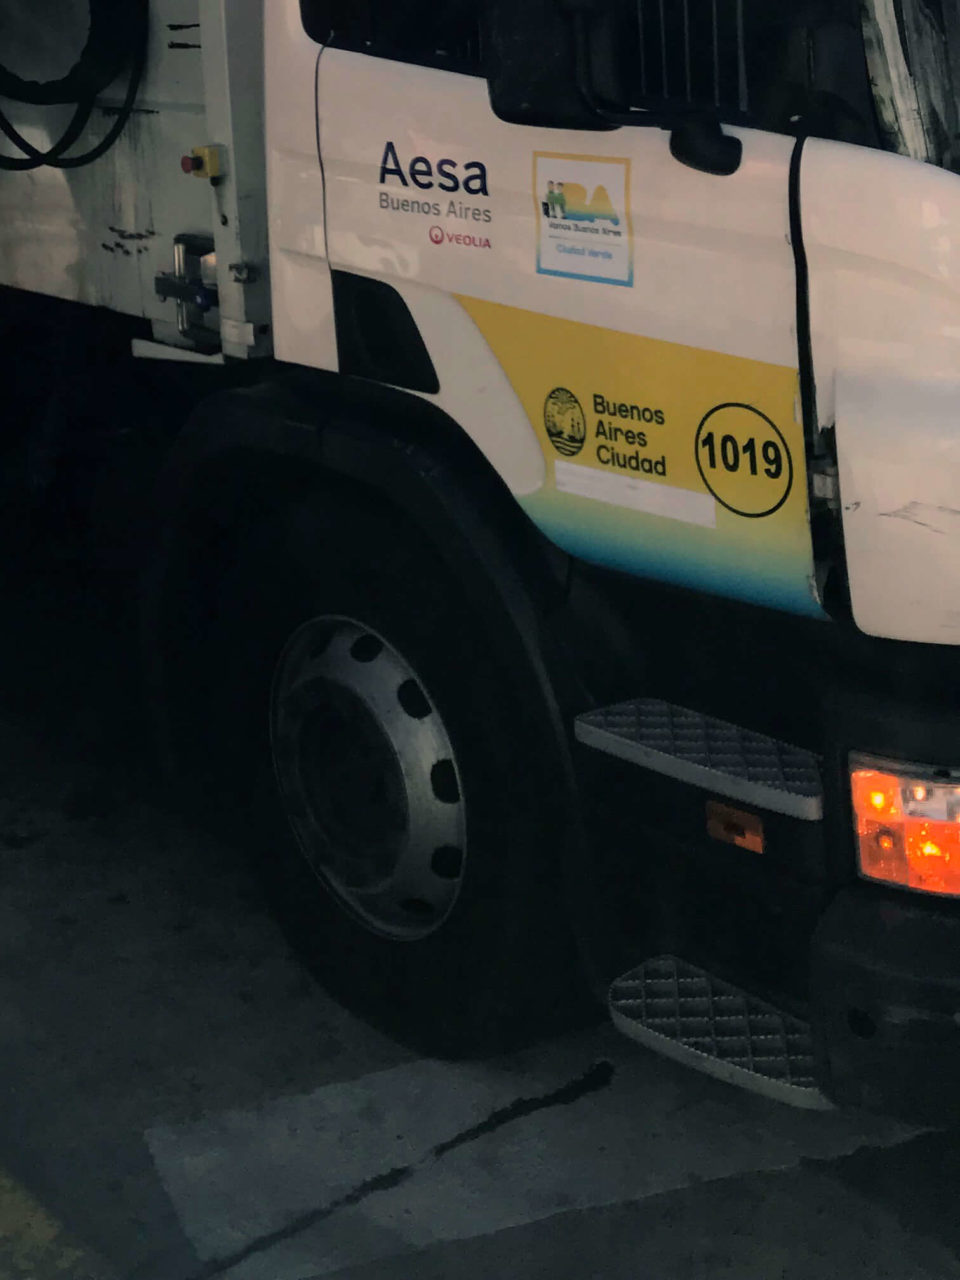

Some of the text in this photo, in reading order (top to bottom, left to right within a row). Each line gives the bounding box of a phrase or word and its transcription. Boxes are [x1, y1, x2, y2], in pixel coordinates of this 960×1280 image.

[379, 141, 489, 197] Aesa
[379, 192, 492, 223] Buenos Aires
[446, 233, 492, 249] VEOLIA
[592, 393, 666, 426] Buenos
[594, 419, 648, 448] Aires
[596, 444, 667, 477] Ciudad
[701, 431, 783, 480] 1019
